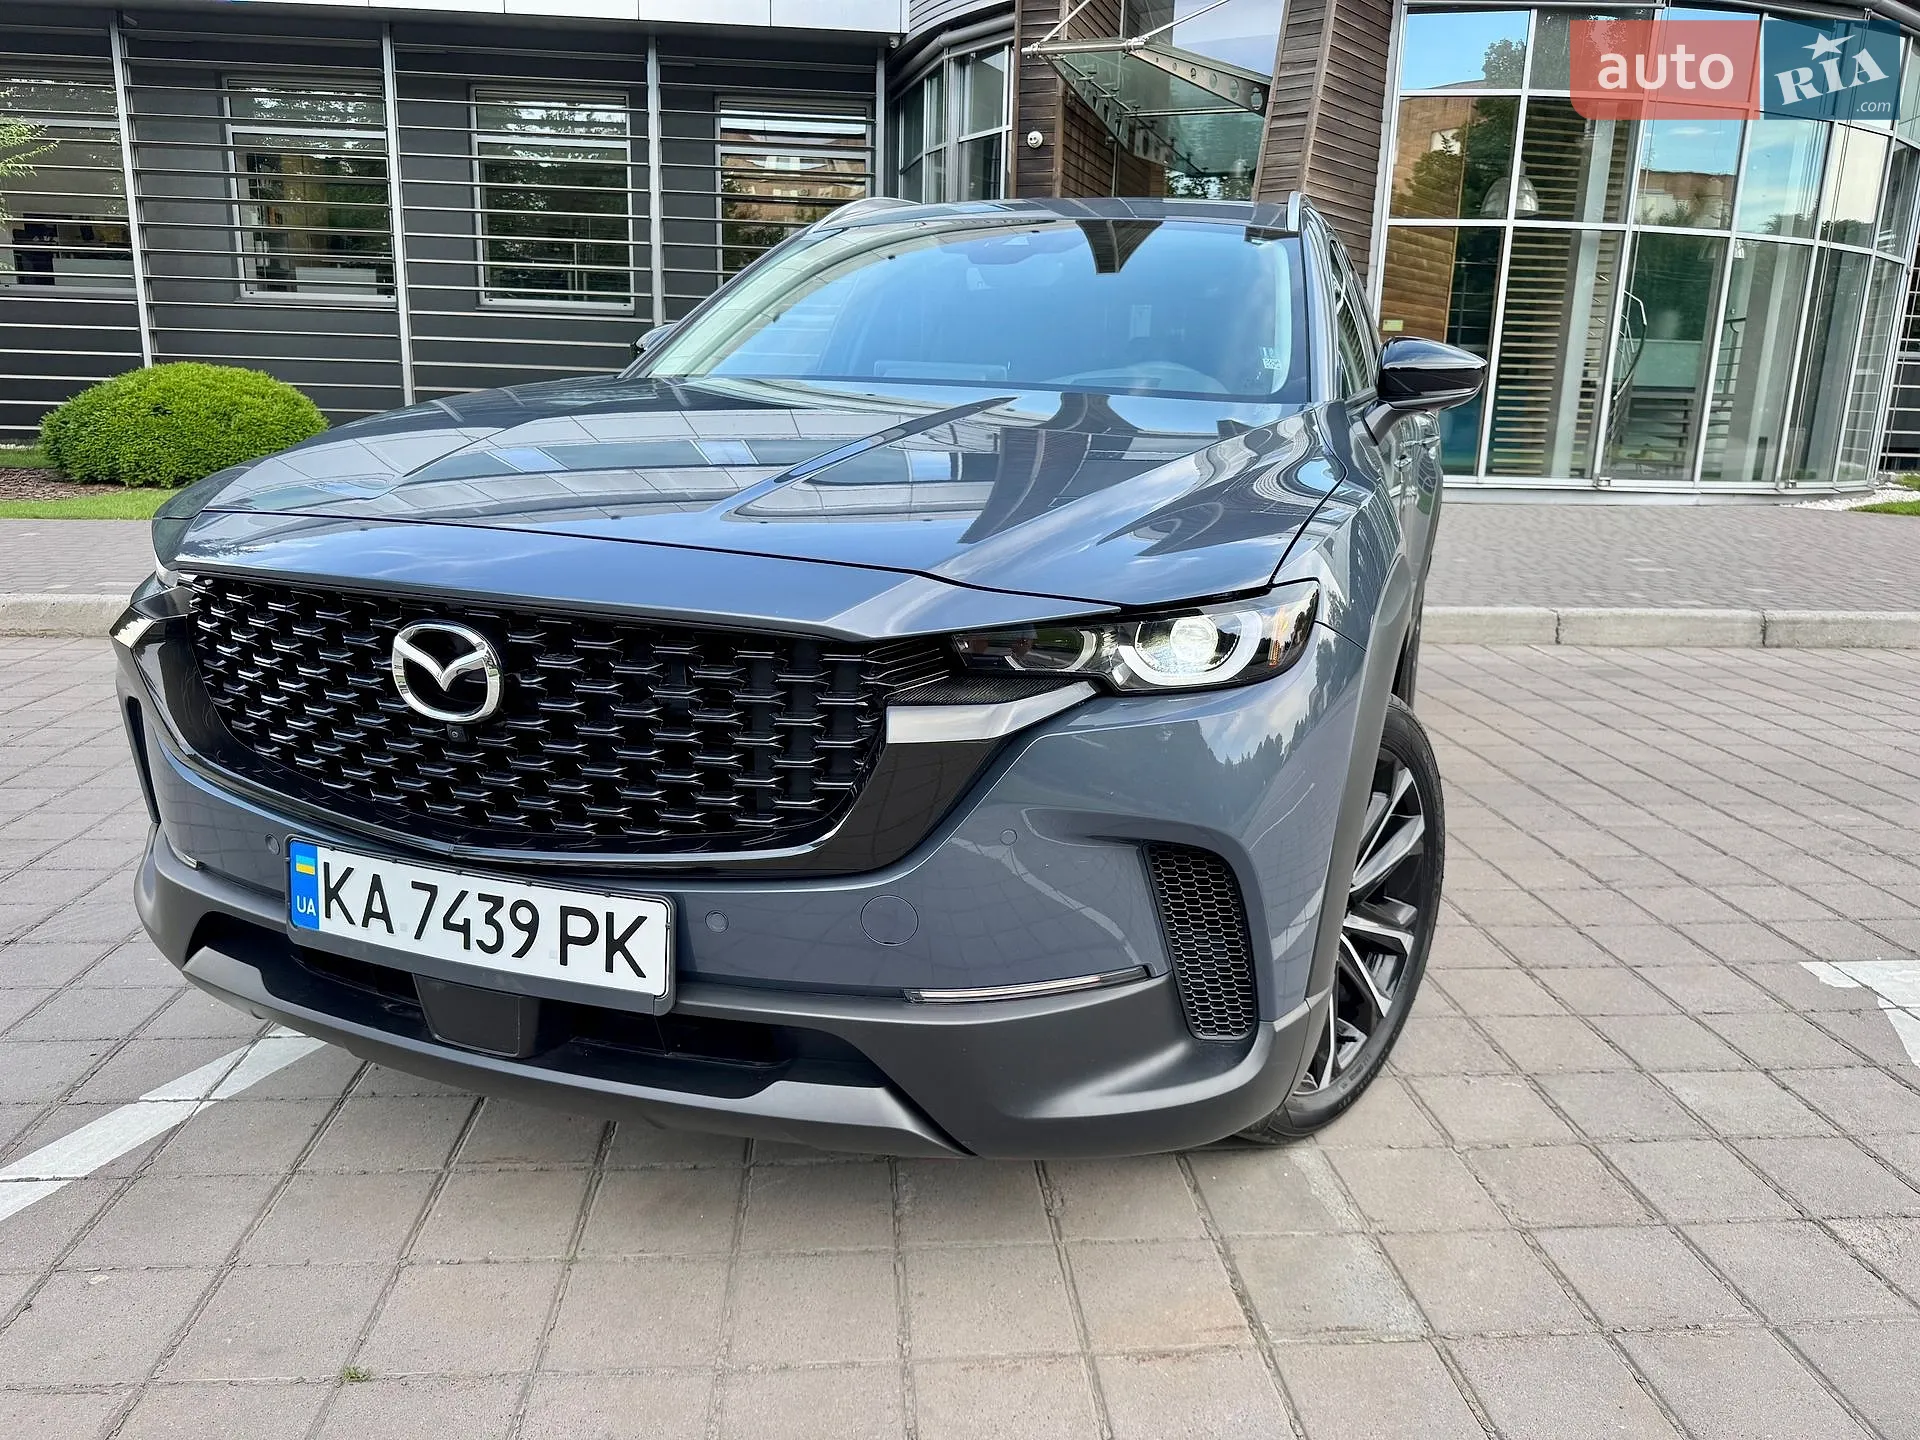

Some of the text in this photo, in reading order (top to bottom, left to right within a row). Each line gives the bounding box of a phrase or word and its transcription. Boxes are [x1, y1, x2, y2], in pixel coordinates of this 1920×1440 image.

[296, 895, 317, 917] UA
[323, 861, 648, 979] KA 7439 PK
